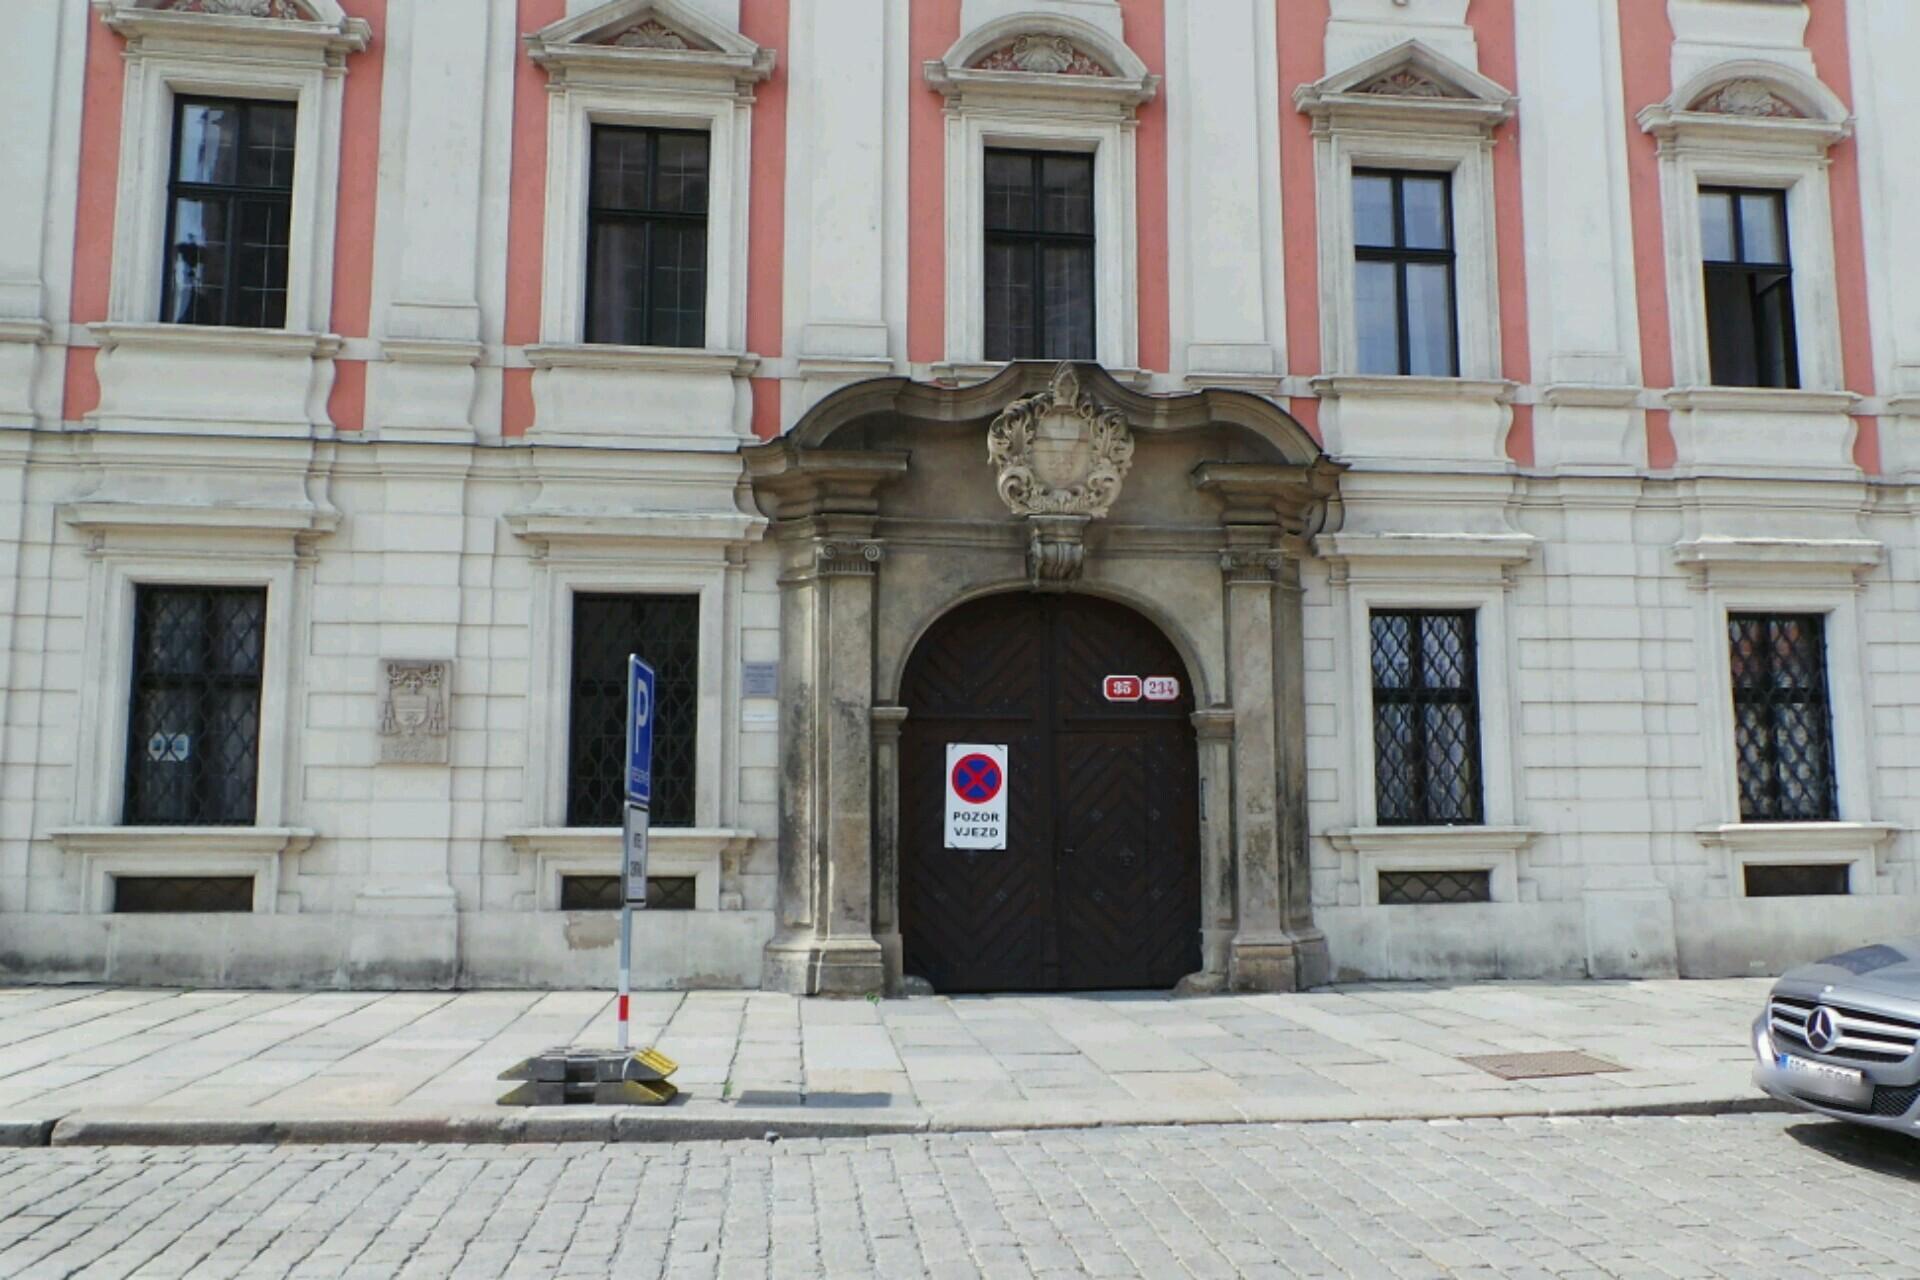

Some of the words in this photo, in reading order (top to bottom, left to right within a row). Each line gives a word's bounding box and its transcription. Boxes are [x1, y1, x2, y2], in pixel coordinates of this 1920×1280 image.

[635, 677, 649, 754] P
[953, 811, 1000, 823] POZOR
[953, 826, 998, 838] VJEZD
